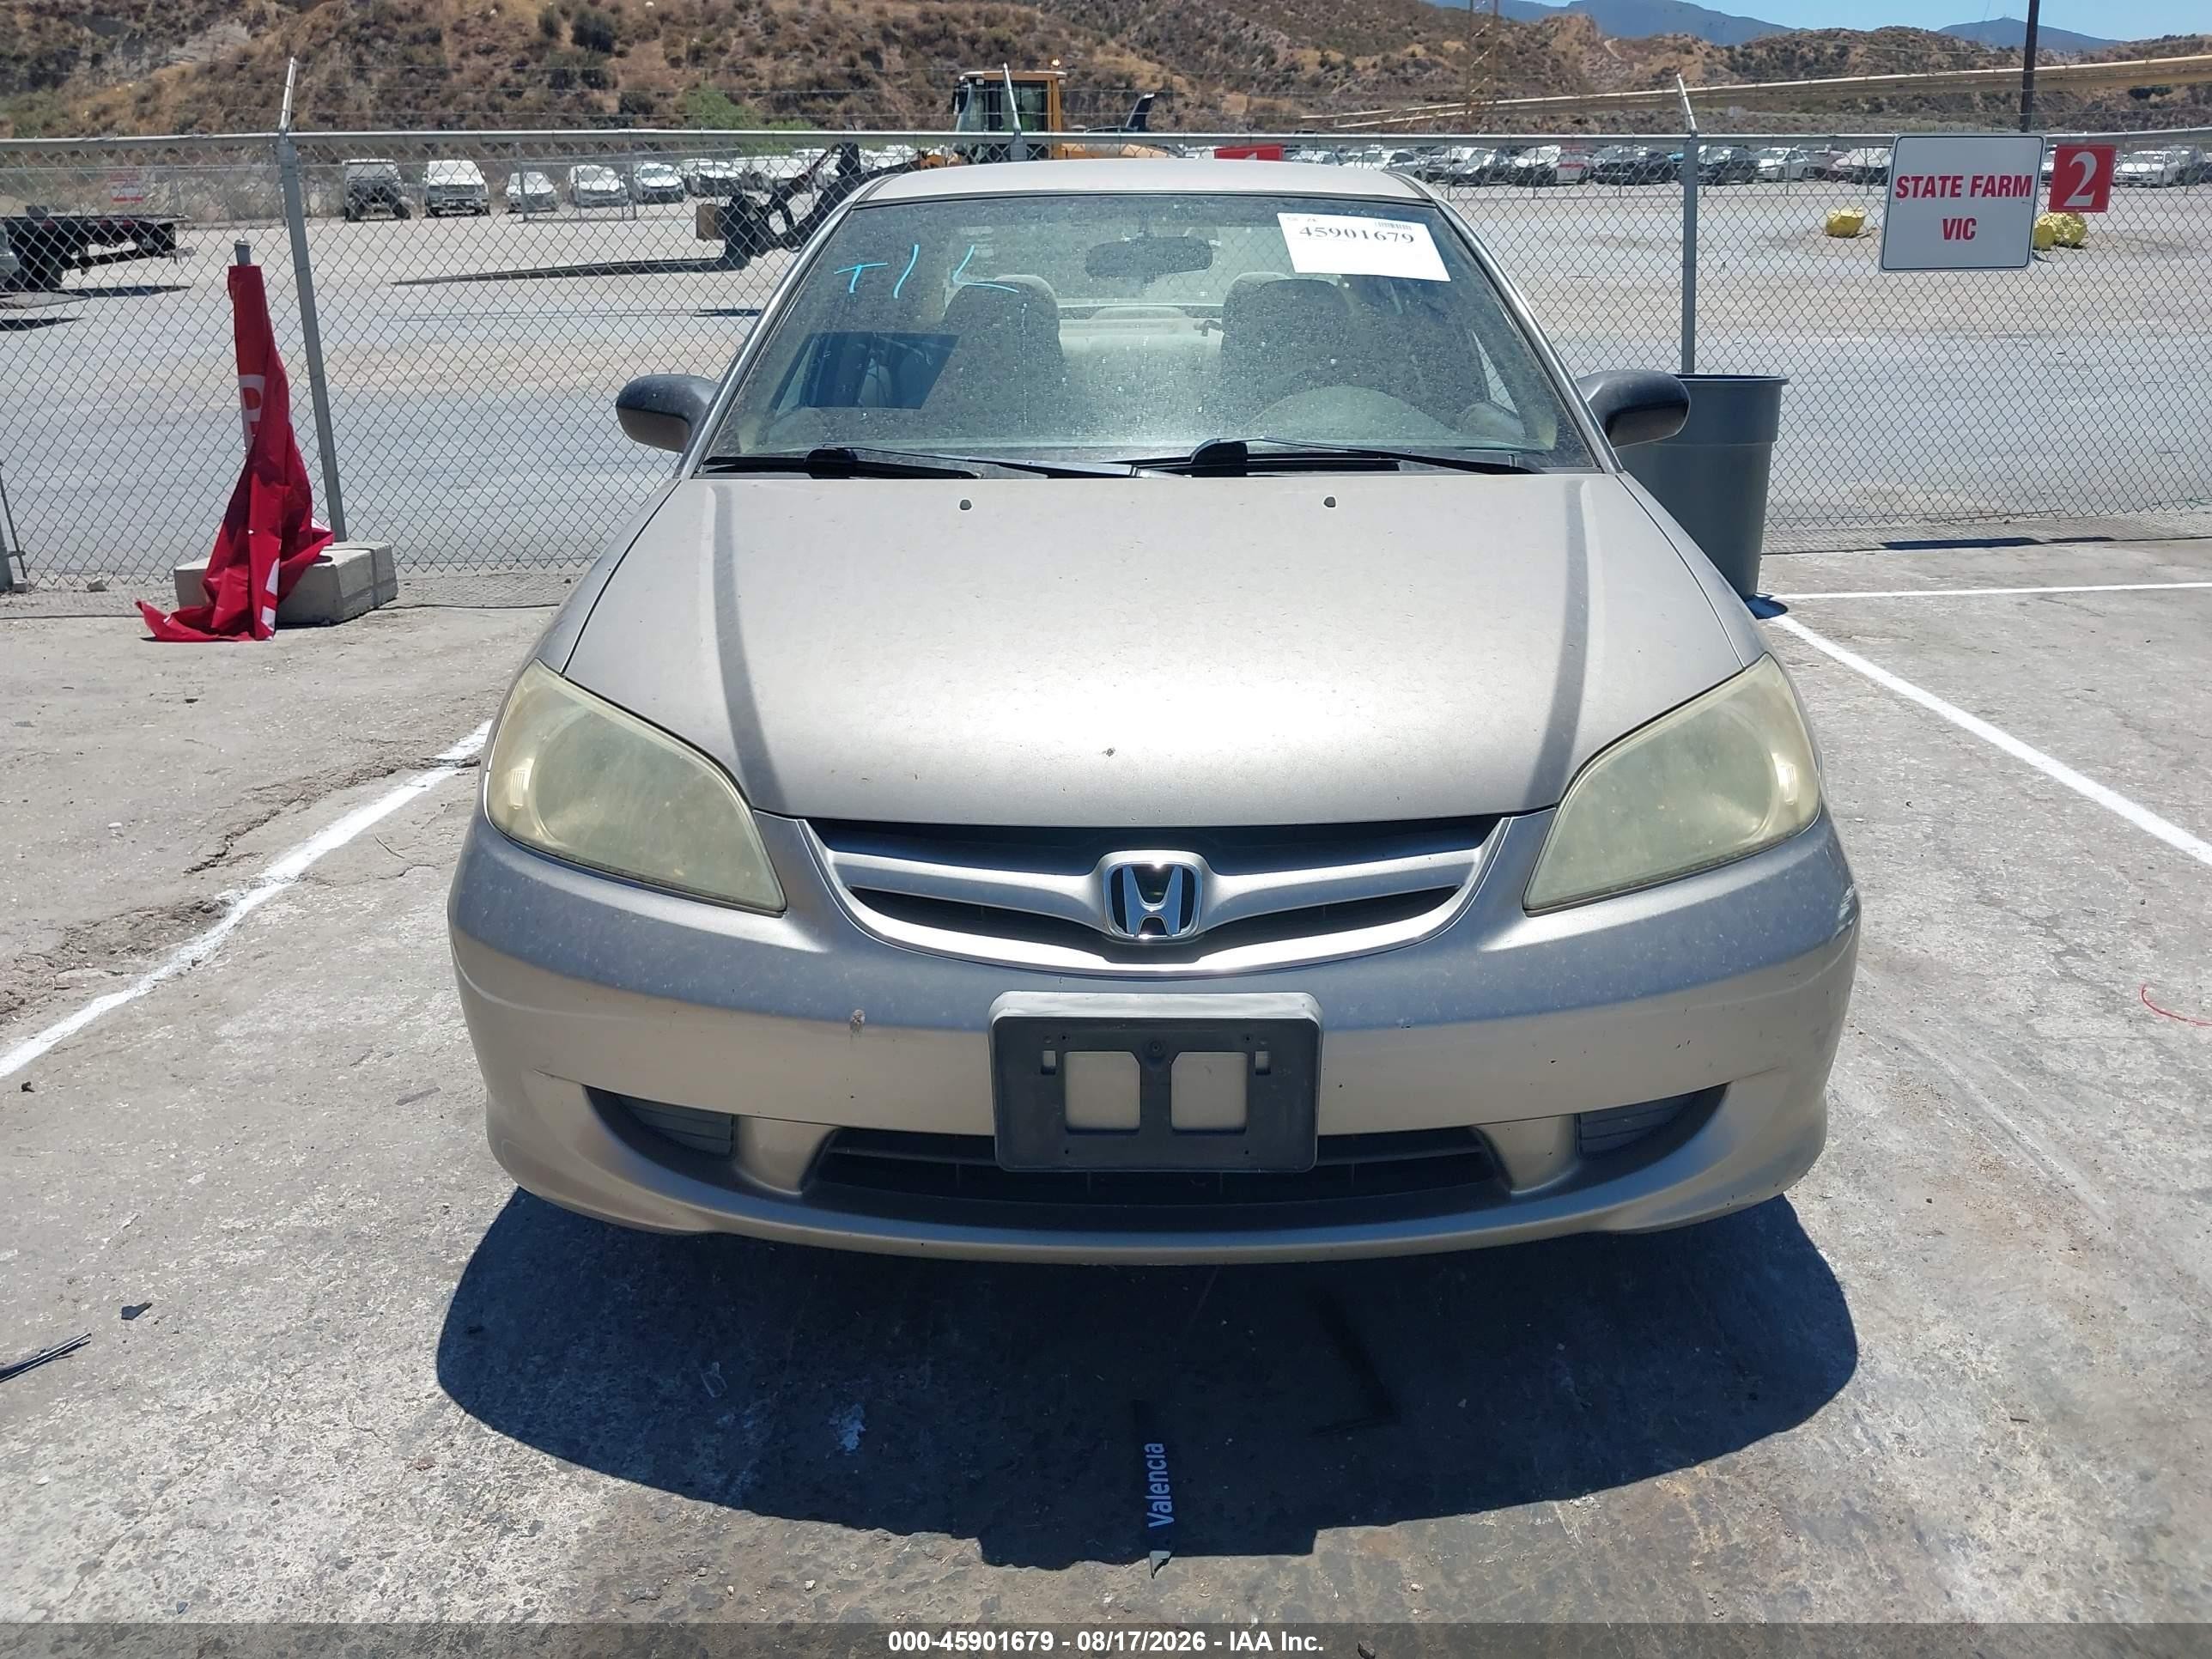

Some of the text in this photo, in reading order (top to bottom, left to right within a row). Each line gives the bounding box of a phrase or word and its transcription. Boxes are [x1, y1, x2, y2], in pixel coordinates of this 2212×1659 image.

[1895, 174, 2033, 198] STATE FARM
[2063, 151, 2097, 206] 2
[1299, 226, 1414, 244] 45901679
[1942, 217, 1977, 240] VIC
[1144, 1443, 1175, 1528] Valencia
